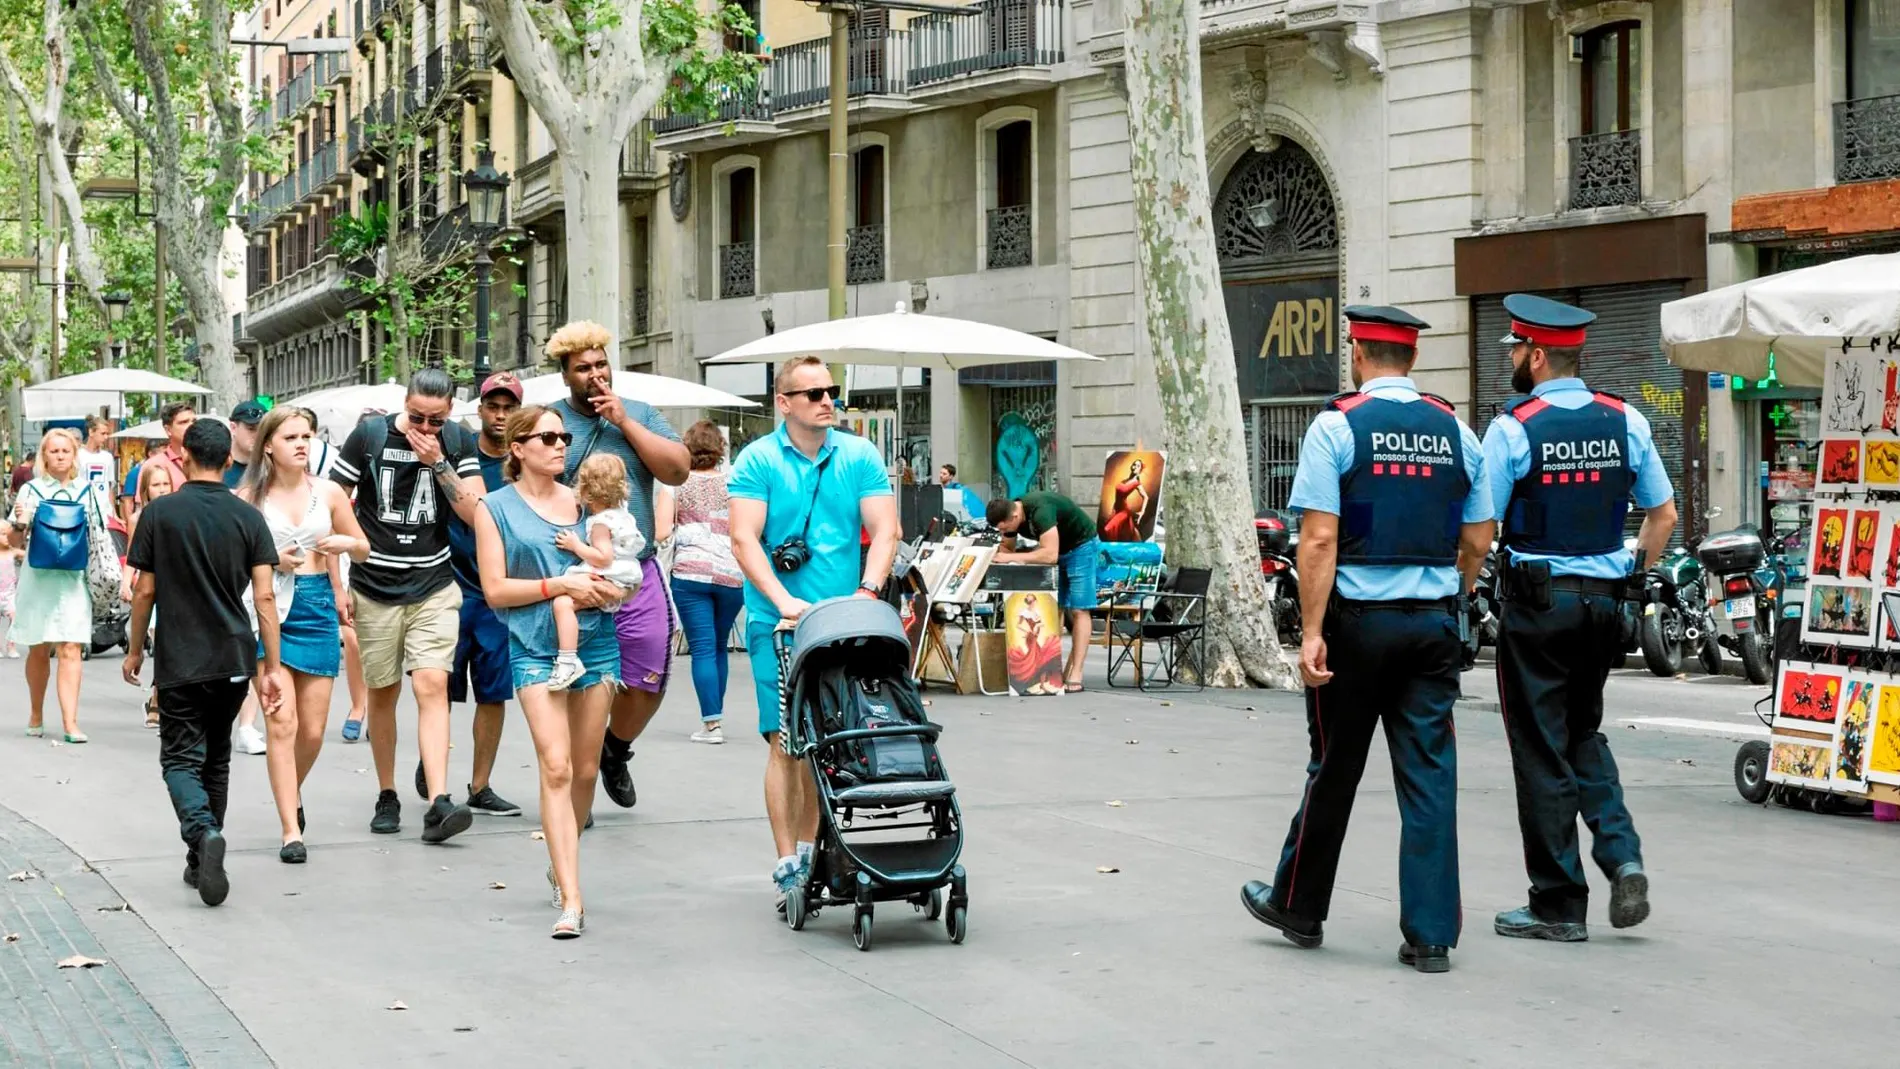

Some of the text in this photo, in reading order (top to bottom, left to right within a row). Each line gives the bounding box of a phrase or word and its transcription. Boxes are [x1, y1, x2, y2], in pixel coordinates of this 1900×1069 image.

[1259, 298, 1333, 358] ARPI
[1371, 432, 1453, 454] POLICIA
[1542, 439, 1621, 461] POLICIA
[1373, 453, 1407, 462] mossos
[1542, 462, 1576, 471] mossos
[378, 466, 438, 524] LA
